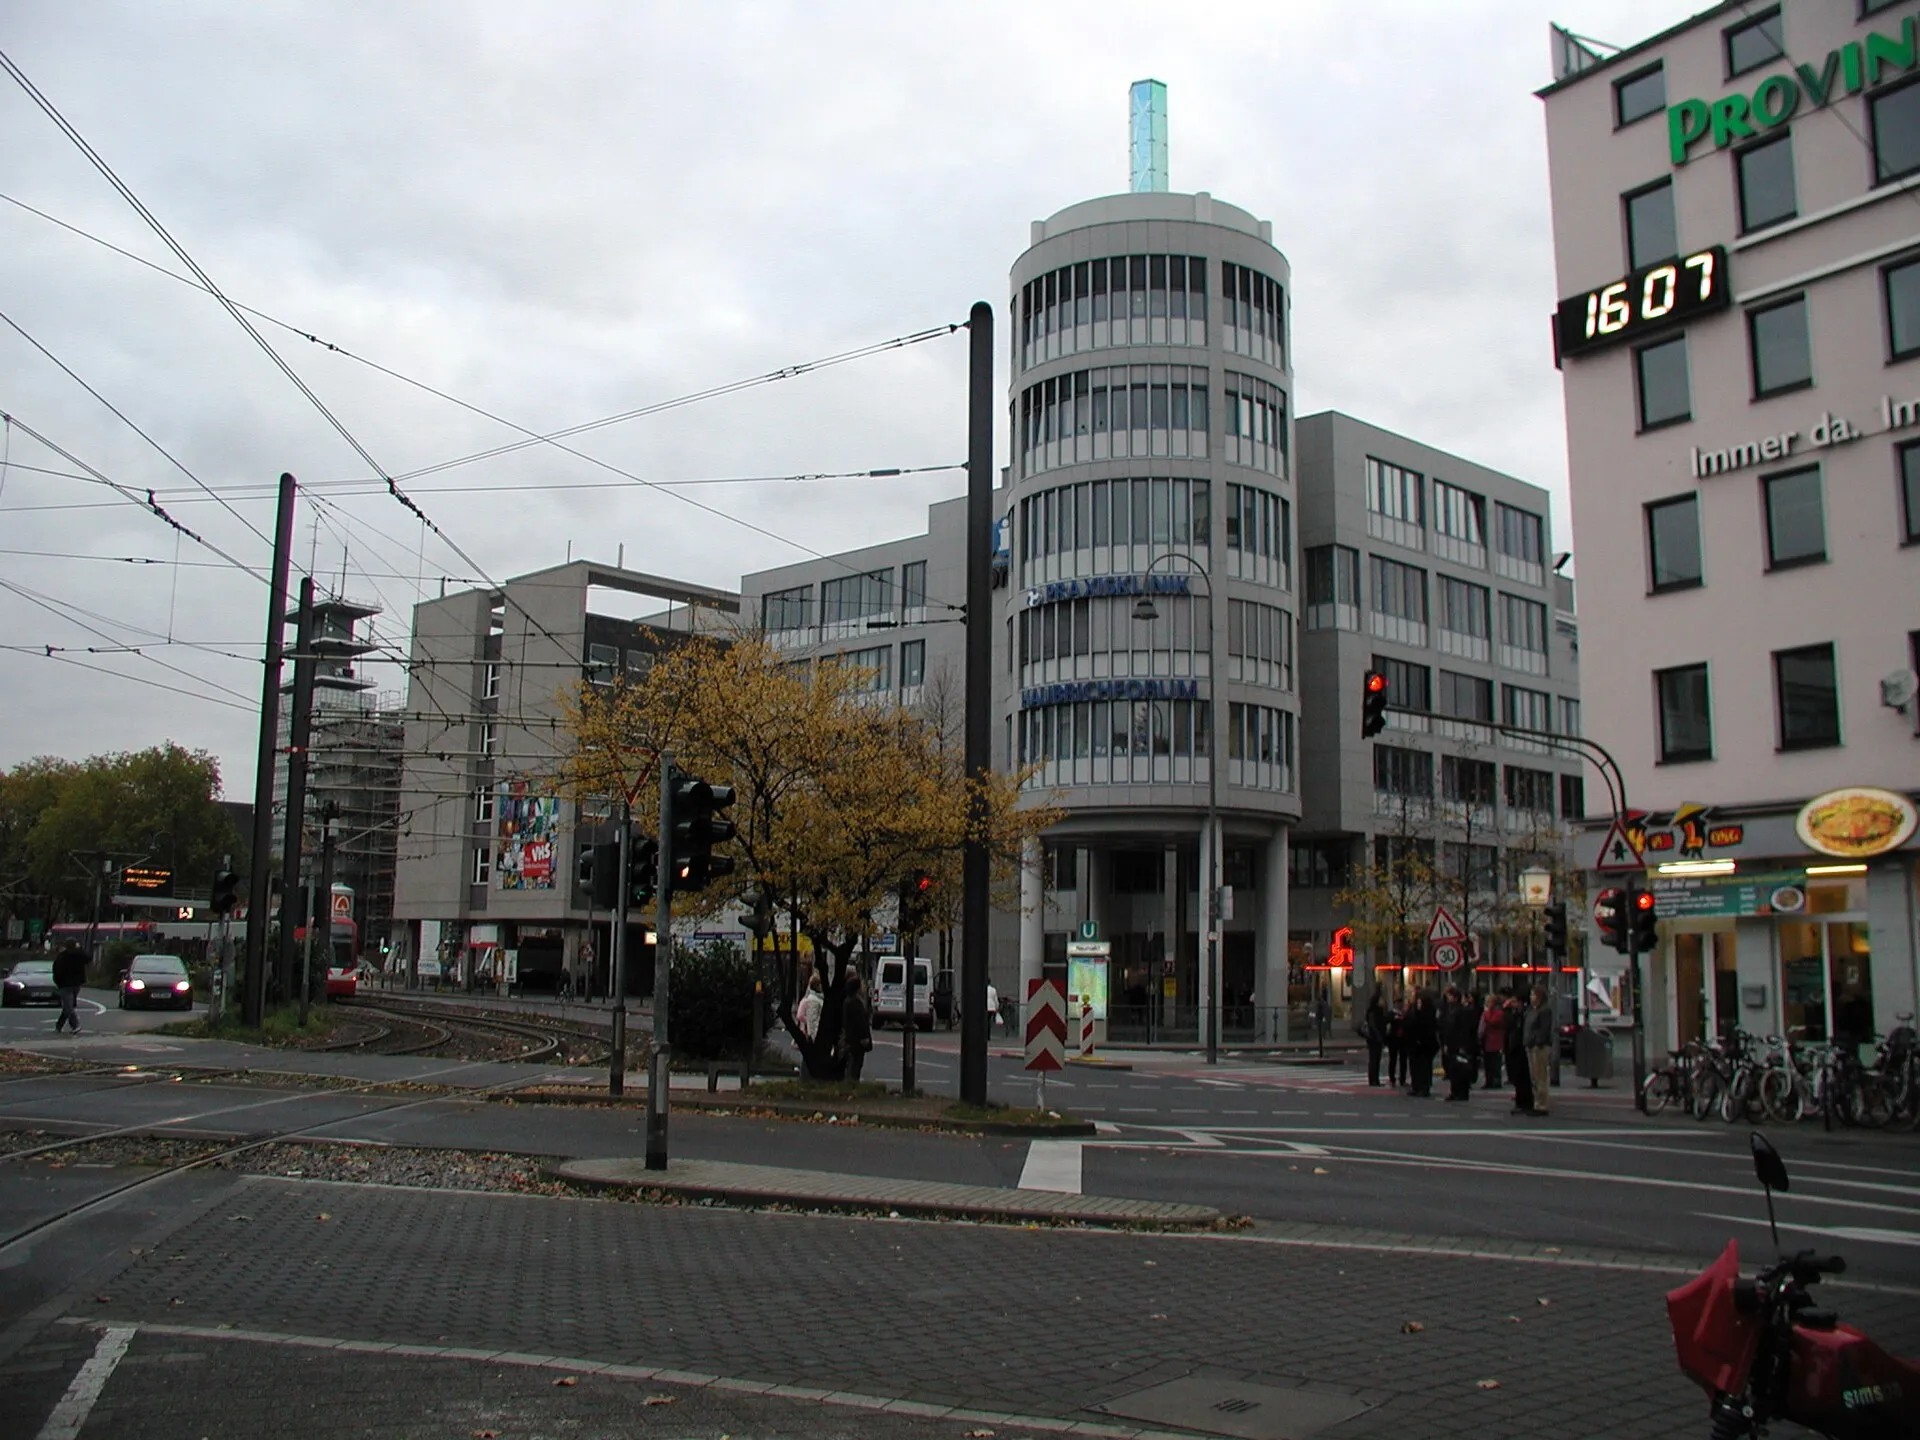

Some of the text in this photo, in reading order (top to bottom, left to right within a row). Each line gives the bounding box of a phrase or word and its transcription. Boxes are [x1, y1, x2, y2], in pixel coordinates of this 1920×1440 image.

[1667, 12, 1920, 166] PROVIN
[1691, 431, 1798, 478] Immer
[1810, 412, 1862, 447] da.
[1045, 575, 1190, 602] PRAXISKLNIK
[531, 842, 551, 862] VHS
[1082, 922, 1095, 939] U
[1438, 949, 1456, 964] 30
